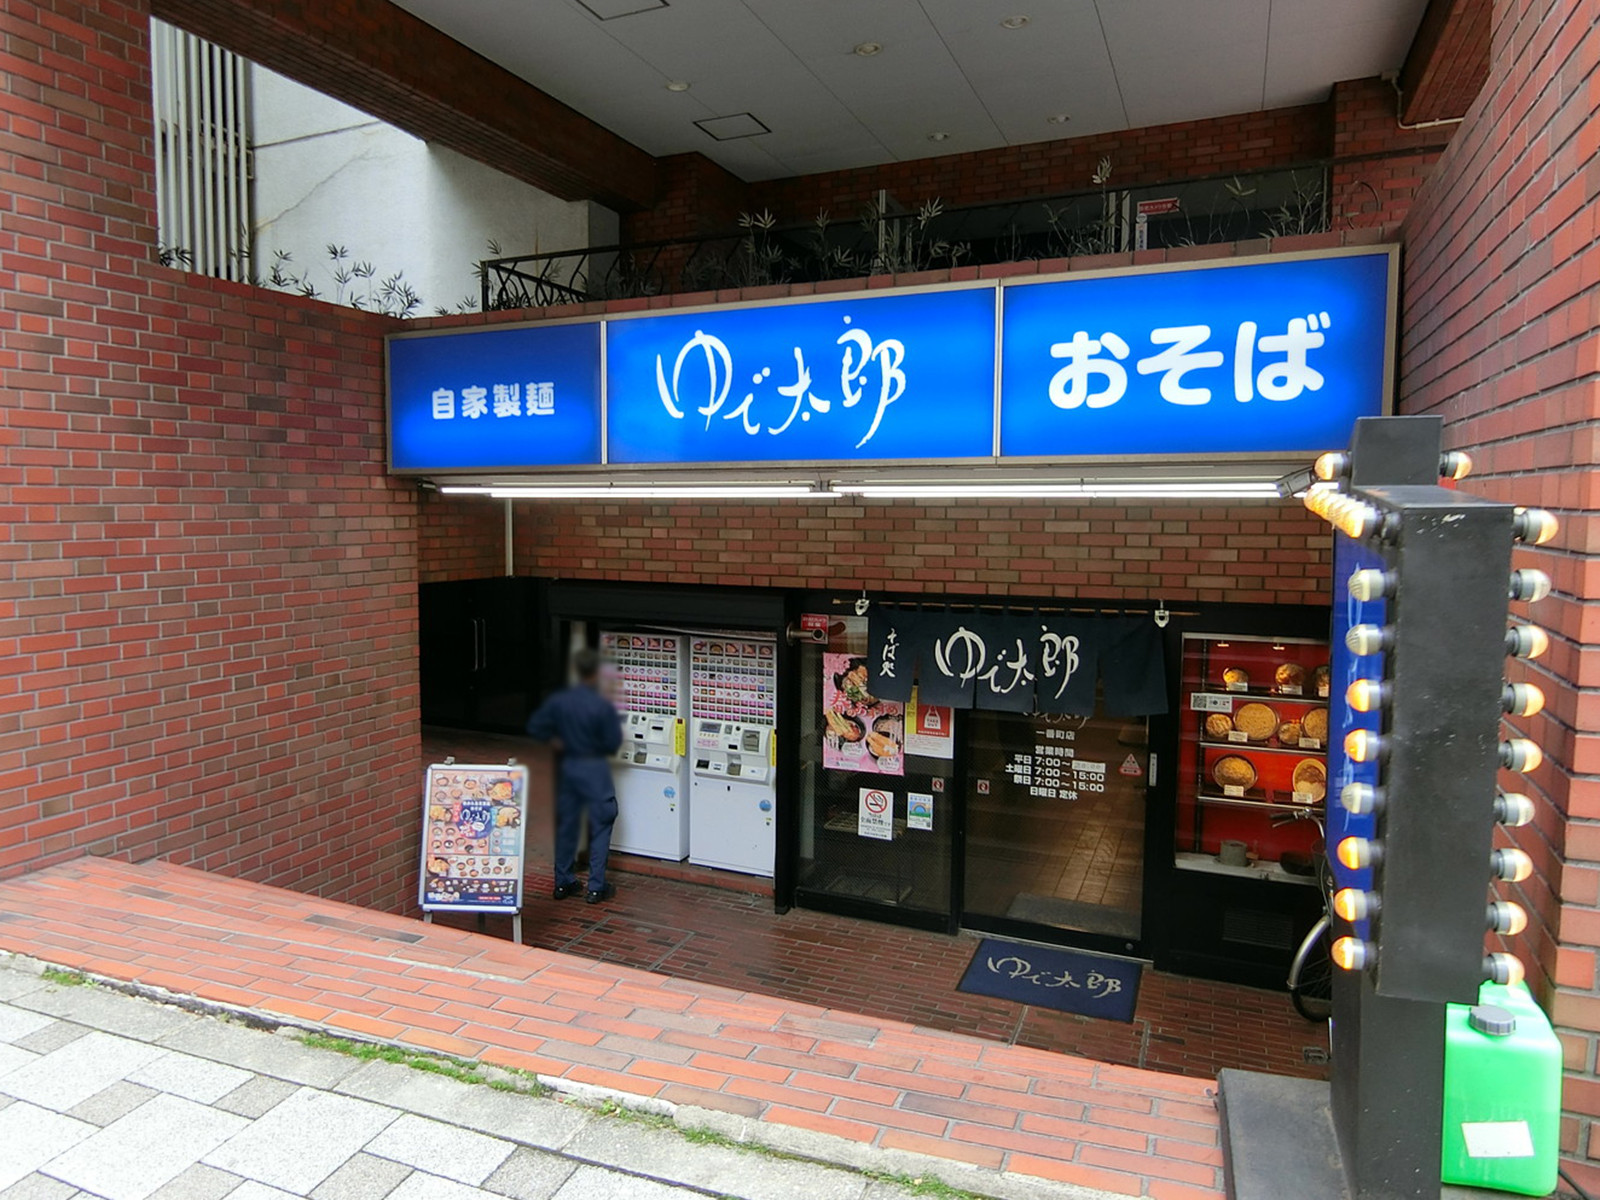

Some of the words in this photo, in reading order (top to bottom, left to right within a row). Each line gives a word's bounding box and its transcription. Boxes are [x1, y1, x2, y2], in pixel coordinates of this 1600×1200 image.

[1049, 312, 1331, 410] おそば
[431, 382, 555, 421] 自家製麺
[655, 315, 906, 449] ゆで太郎
[879, 628, 900, 678] そば処
[934, 625, 1080, 700] ゆで太郎
[1035, 745, 1074, 758] 営業時間
[1036, 729, 1075, 741] 一番町店
[1005, 763, 1032, 774] 土曜日
[1014, 754, 1032, 765] 平日
[1030, 786, 1057, 798] 日曜日
[1059, 790, 1079, 801] 定休
[987, 956, 1122, 998] ゆで太郎
